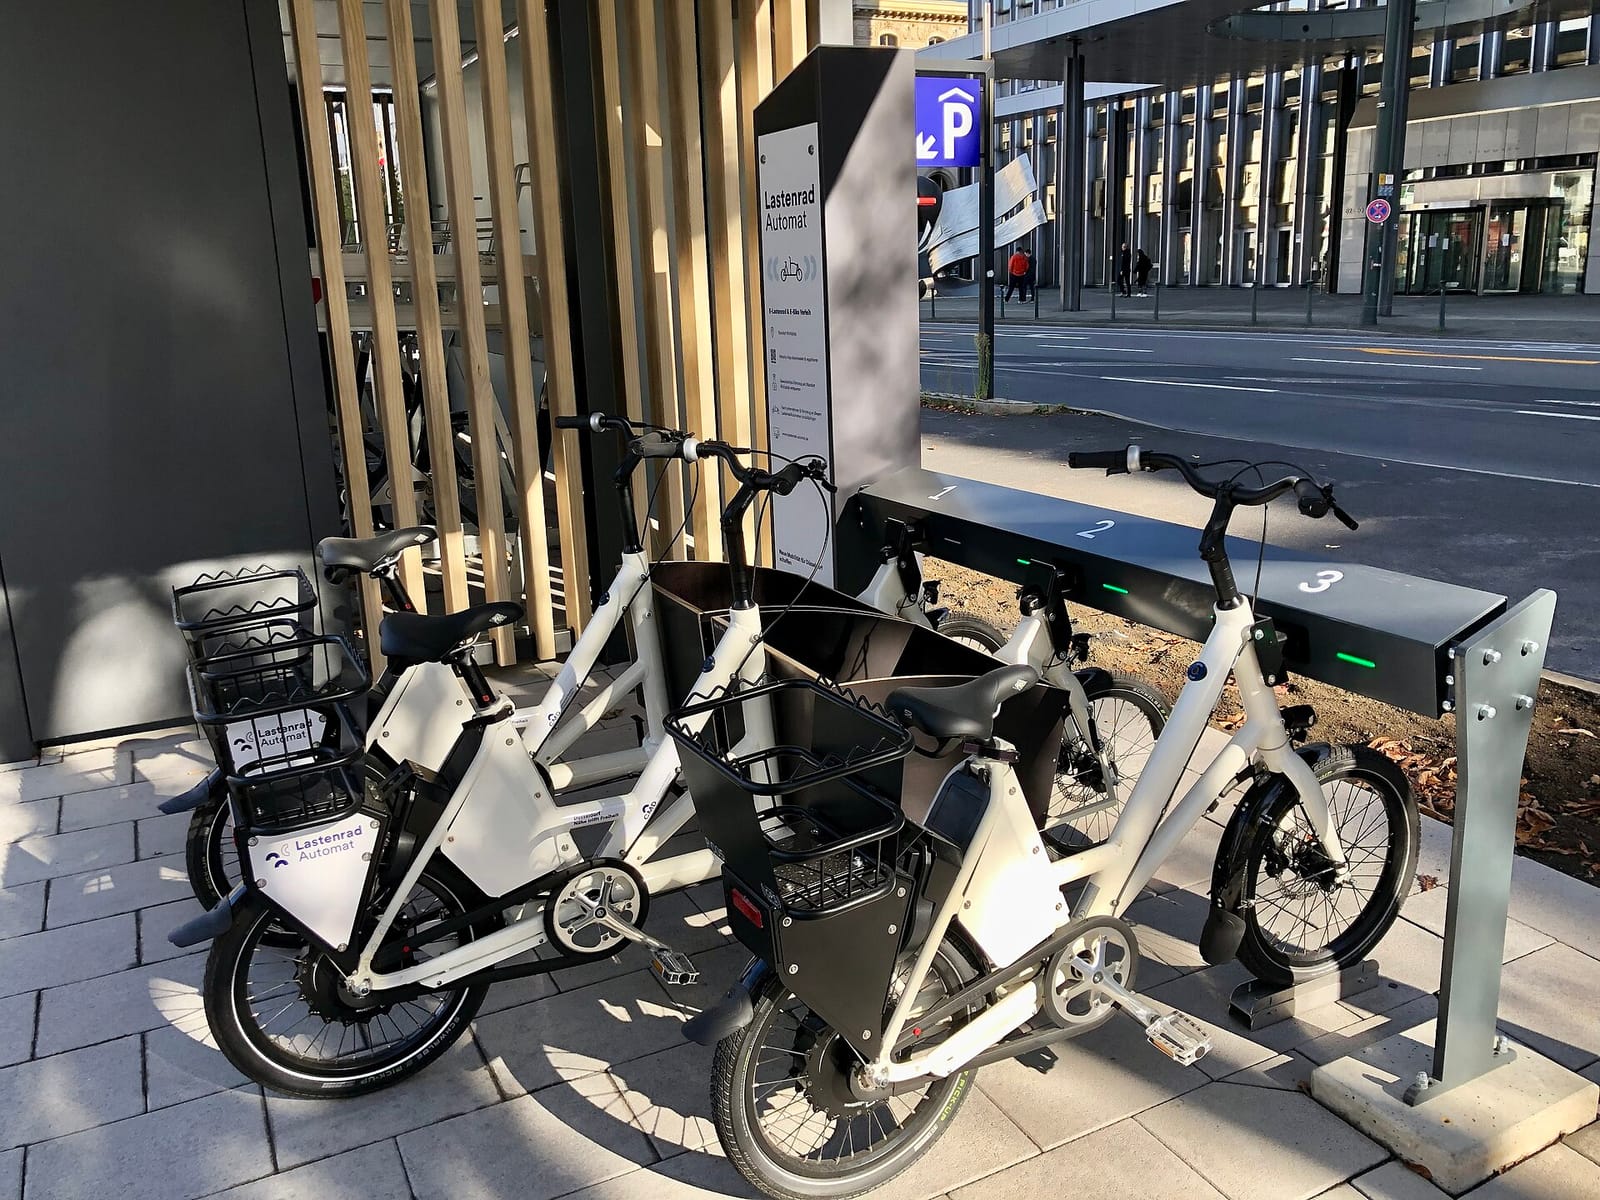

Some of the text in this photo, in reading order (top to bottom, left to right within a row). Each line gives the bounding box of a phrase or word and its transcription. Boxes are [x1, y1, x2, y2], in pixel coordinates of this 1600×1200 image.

[943, 102, 973, 159] P
[764, 184, 815, 210] Lastenrad
[765, 211, 808, 232] Automat
[928, 485, 958, 501] 1
[1076, 519, 1115, 539] 2
[1297, 569, 1345, 593] 3
[257, 718, 313, 738] Lastenrad
[260, 731, 307, 748] Automat
[295, 825, 363, 851] Lastenrad
[298, 840, 355, 863] Automat
[417, 1016, 461, 1060] SCHWALBE
[939, 1078, 967, 1121] PICK-UP
